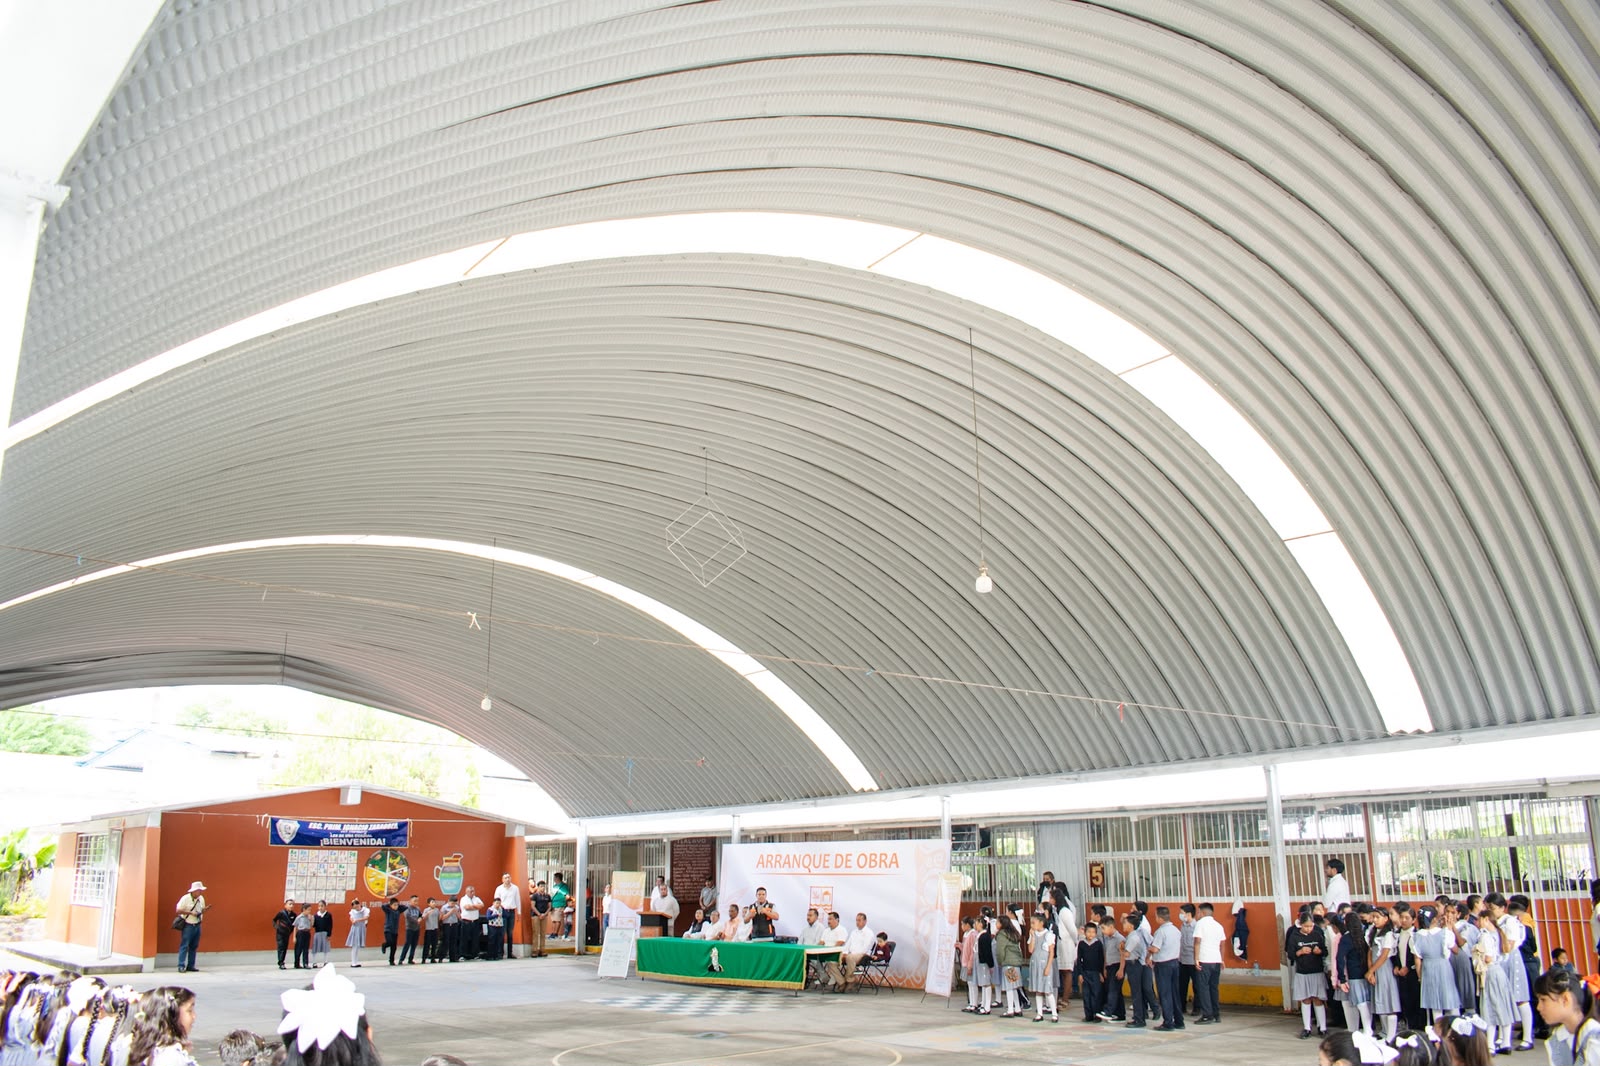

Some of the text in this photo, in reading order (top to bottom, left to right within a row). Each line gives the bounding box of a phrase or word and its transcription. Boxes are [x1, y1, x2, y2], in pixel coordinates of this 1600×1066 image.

[320, 838, 386, 846] ¡BIENVENIDA!
[756, 852, 900, 873] ARRANQUE DE OBRA
